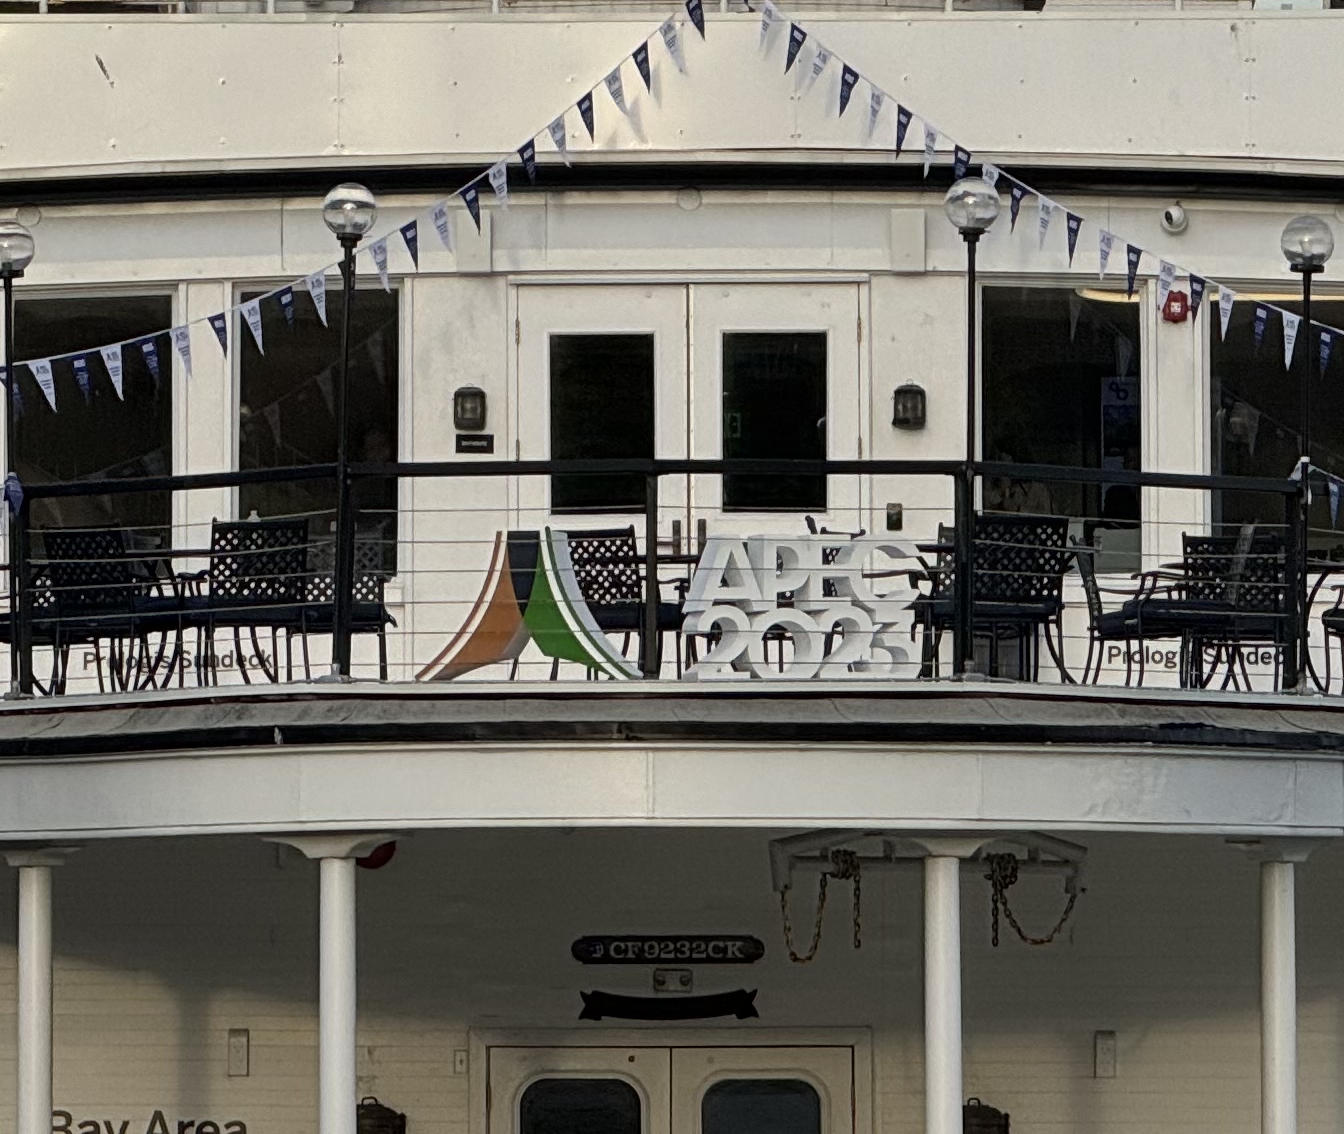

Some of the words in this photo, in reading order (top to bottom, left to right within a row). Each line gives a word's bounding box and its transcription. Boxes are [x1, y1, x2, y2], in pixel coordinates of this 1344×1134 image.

[682, 534, 928, 614] APEC
[682, 604, 924, 680] 2023
[1107, 645, 1179, 669] Prolog
[609, 941, 745, 959] CF9232CK
